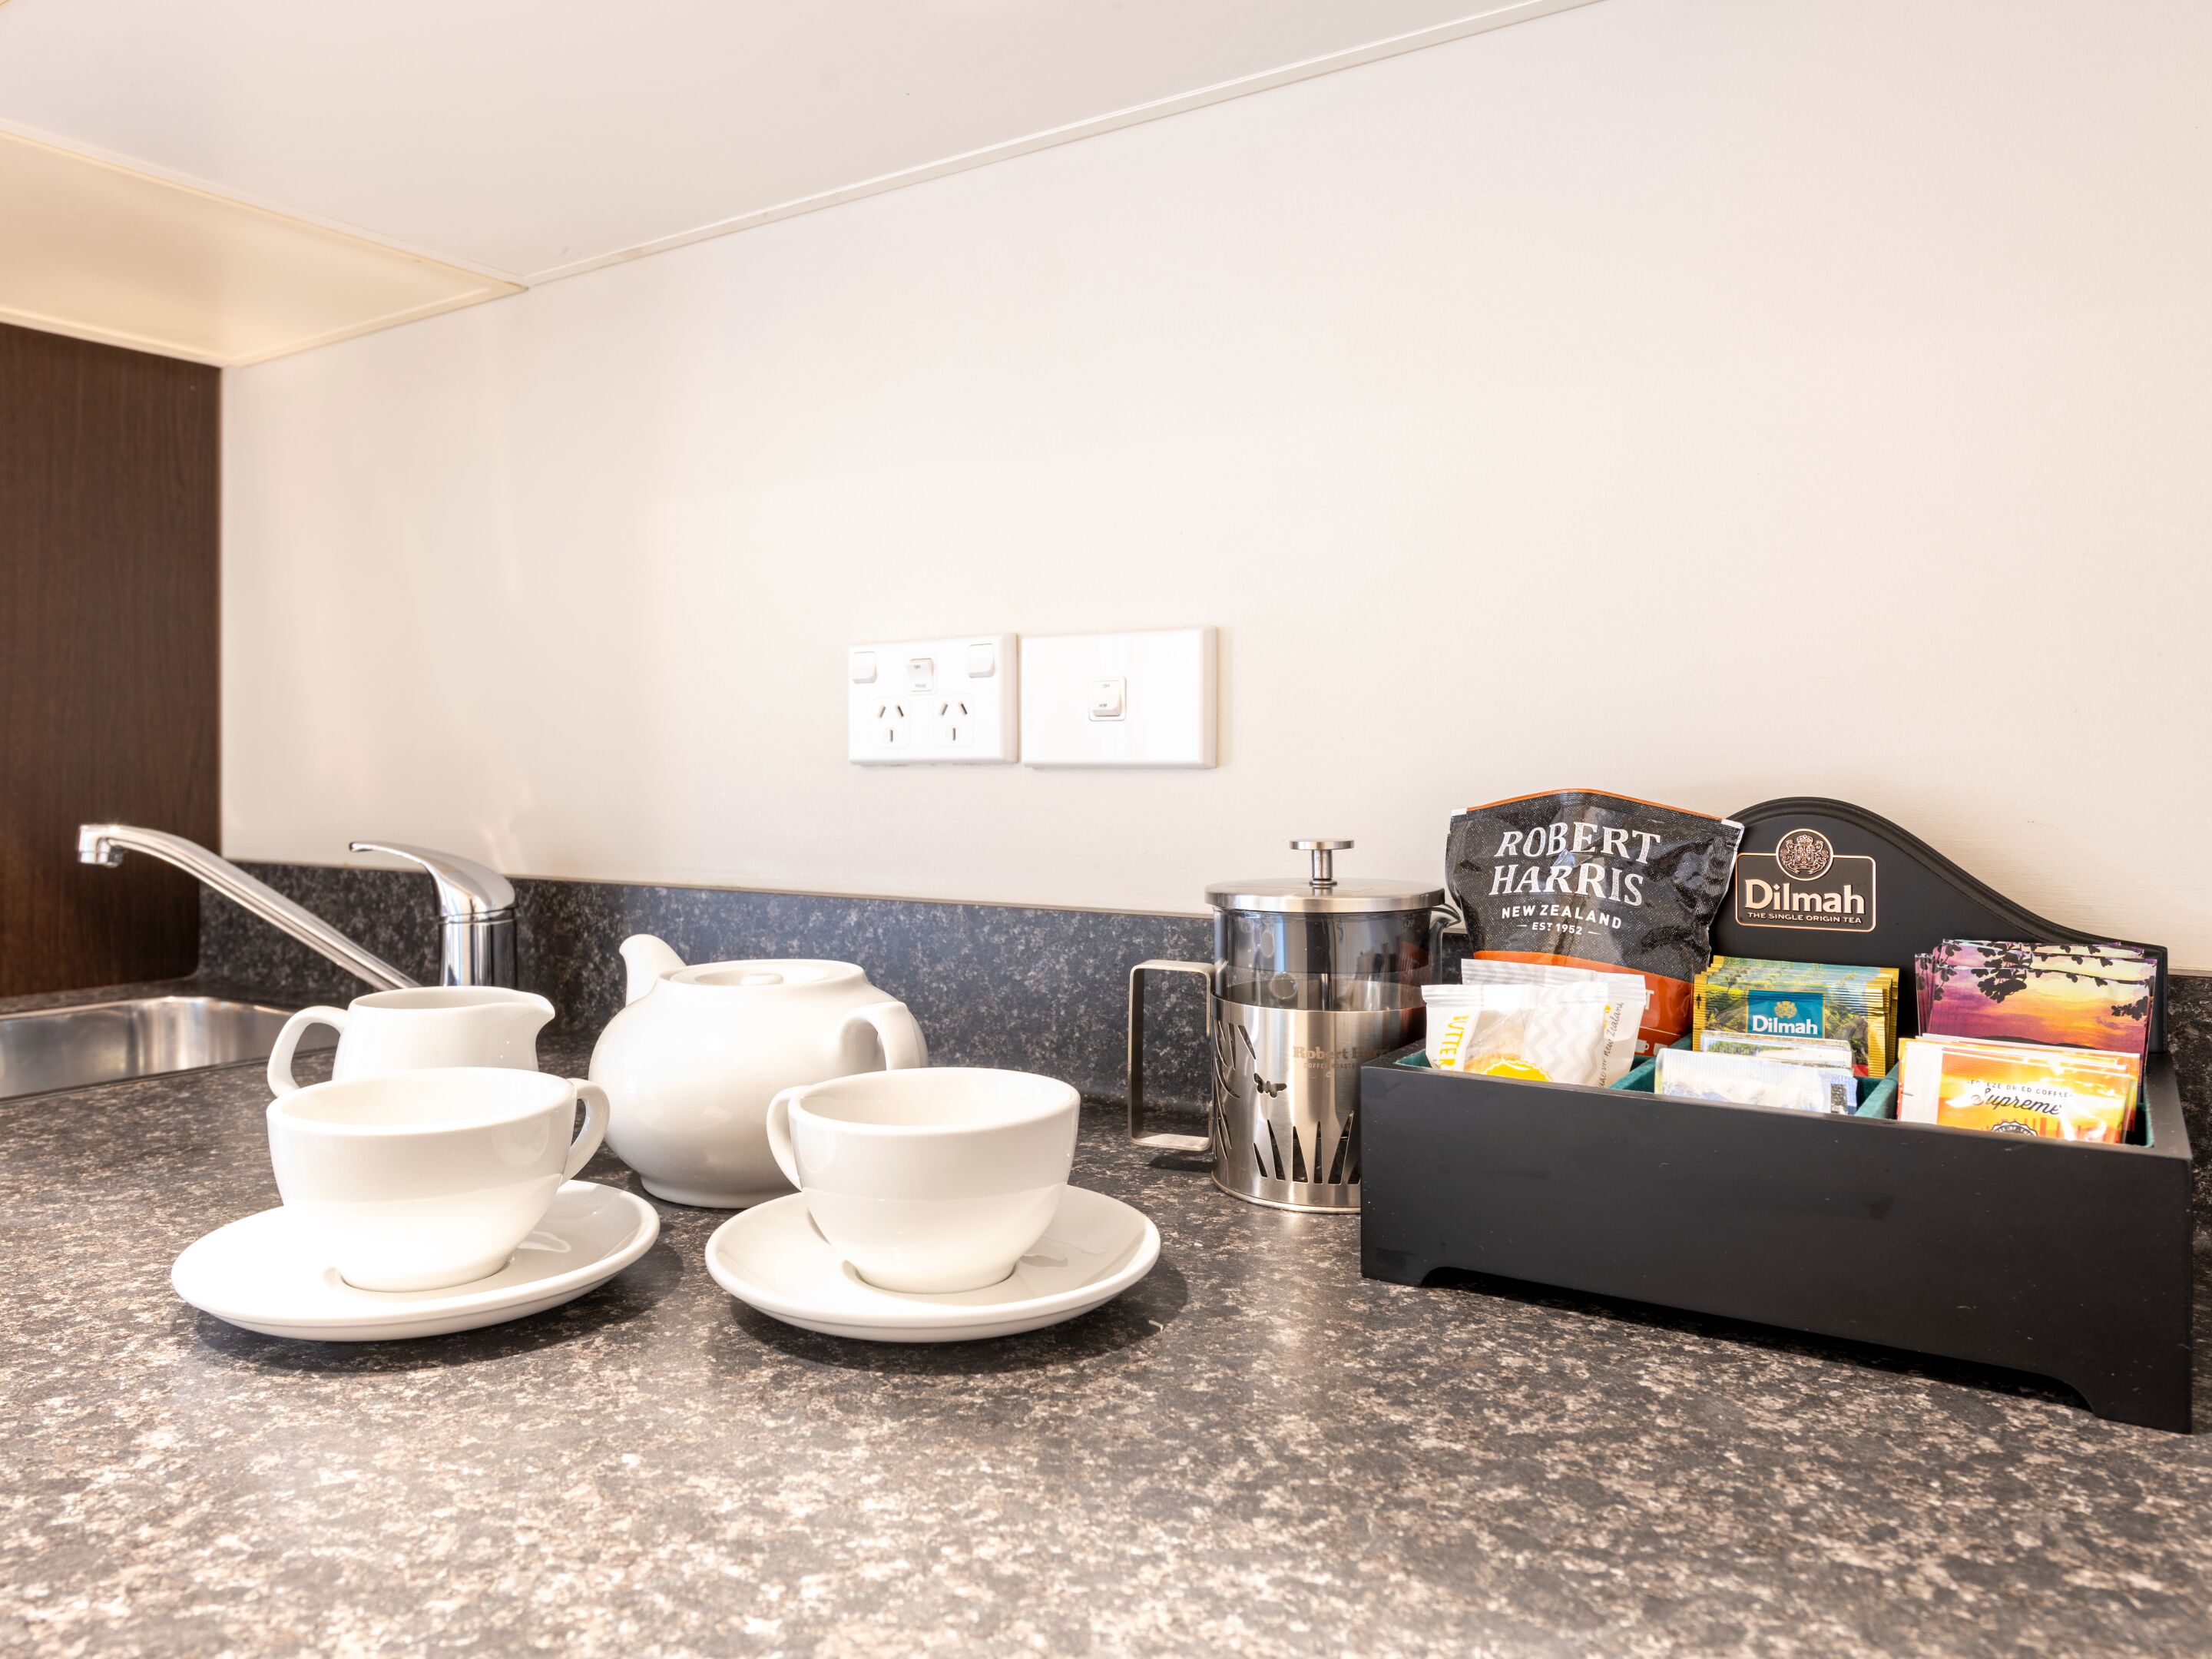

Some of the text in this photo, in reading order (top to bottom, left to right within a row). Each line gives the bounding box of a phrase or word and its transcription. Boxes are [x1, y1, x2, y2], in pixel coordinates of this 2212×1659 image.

[1494, 822, 1661, 865] ROBERT
[1488, 863, 1644, 906] HARRIS
[1745, 879, 1866, 915] Dilmah
[1502, 904, 1622, 929] NEW ZEALAND
[1556, 923, 1583, 935] 1952
[1752, 1015, 1818, 1035] Dilmah
[1293, 1045, 1349, 1060] Robert
[1971, 1088, 2061, 1115] Supreme
